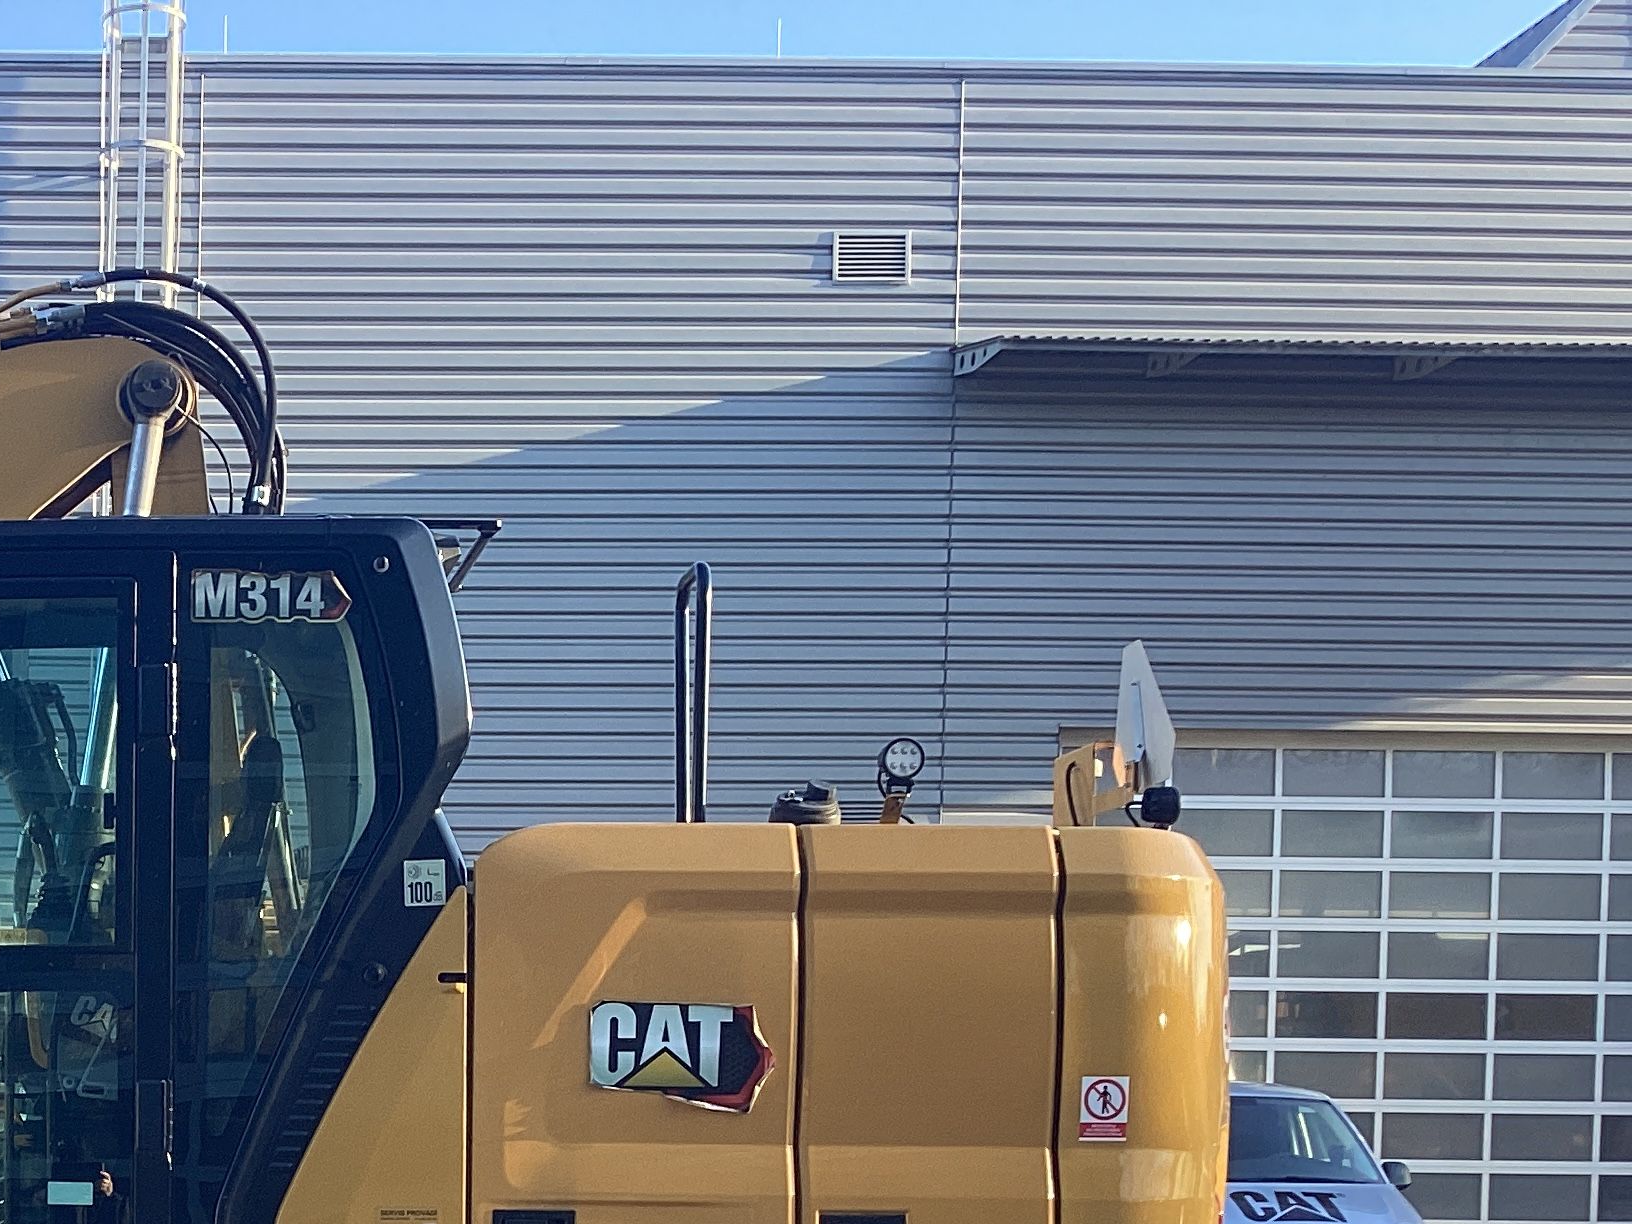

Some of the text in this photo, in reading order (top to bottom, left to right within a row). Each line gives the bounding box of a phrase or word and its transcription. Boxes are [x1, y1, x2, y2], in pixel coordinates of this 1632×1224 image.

[195, 572, 325, 619] M314
[408, 881, 433, 903] 100
[591, 1002, 734, 1088] CAT
[1230, 1191, 1347, 1223] CAT
